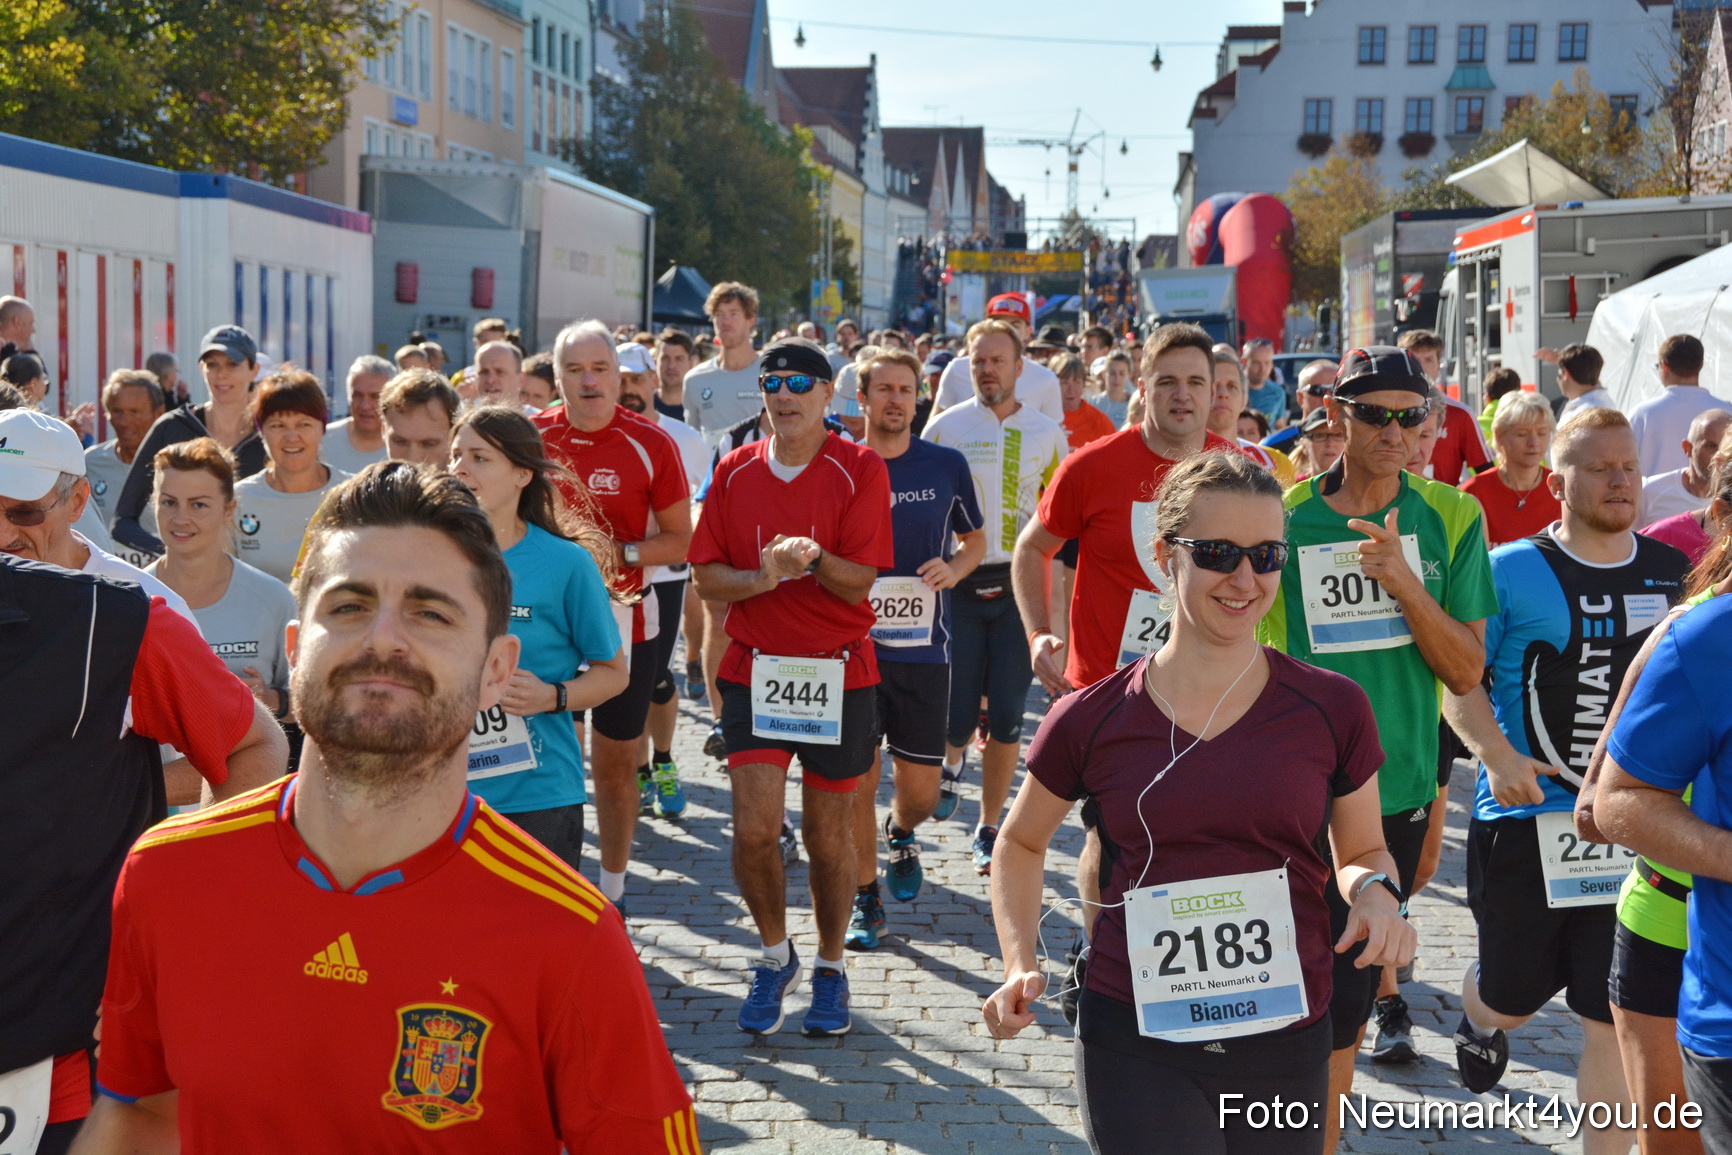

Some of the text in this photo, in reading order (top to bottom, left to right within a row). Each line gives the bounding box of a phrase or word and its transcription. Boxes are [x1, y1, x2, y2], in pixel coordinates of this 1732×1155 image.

[963, 449, 997, 457] othsee
[967, 457, 997, 465] athlon
[1002, 427, 1022, 512] FINISHER
[898, 488, 936, 503] POLES
[1334, 552, 1361, 564] BO
[1320, 573, 1397, 608] 301
[510, 605, 532, 618] CK
[870, 597, 923, 618] 2626
[1331, 607, 1393, 619] PARTL Neumarkt
[876, 630, 913, 640] Stephan
[1138, 616, 1171, 646] 24
[778, 664, 818, 675] BOCK
[1569, 595, 1614, 766] HIMATEC
[765, 680, 829, 707] 2444
[474, 703, 508, 735] 09
[769, 719, 823, 733] Alexander
[1569, 864, 1628, 874] PARTL Neumarkt
[1580, 877, 1621, 894] Severi
[1171, 890, 1246, 915] BOCK
[1173, 911, 1196, 921] inspired
[1204, 909, 1221, 917] smart
[1222, 907, 1247, 916] concepts
[1153, 919, 1272, 977] 2183
[304, 961, 369, 985] adidas
[1142, 970, 1149, 978] B
[1170, 975, 1256, 993] PARTL Neumarkt
[1189, 1000, 1258, 1023] Bianca
